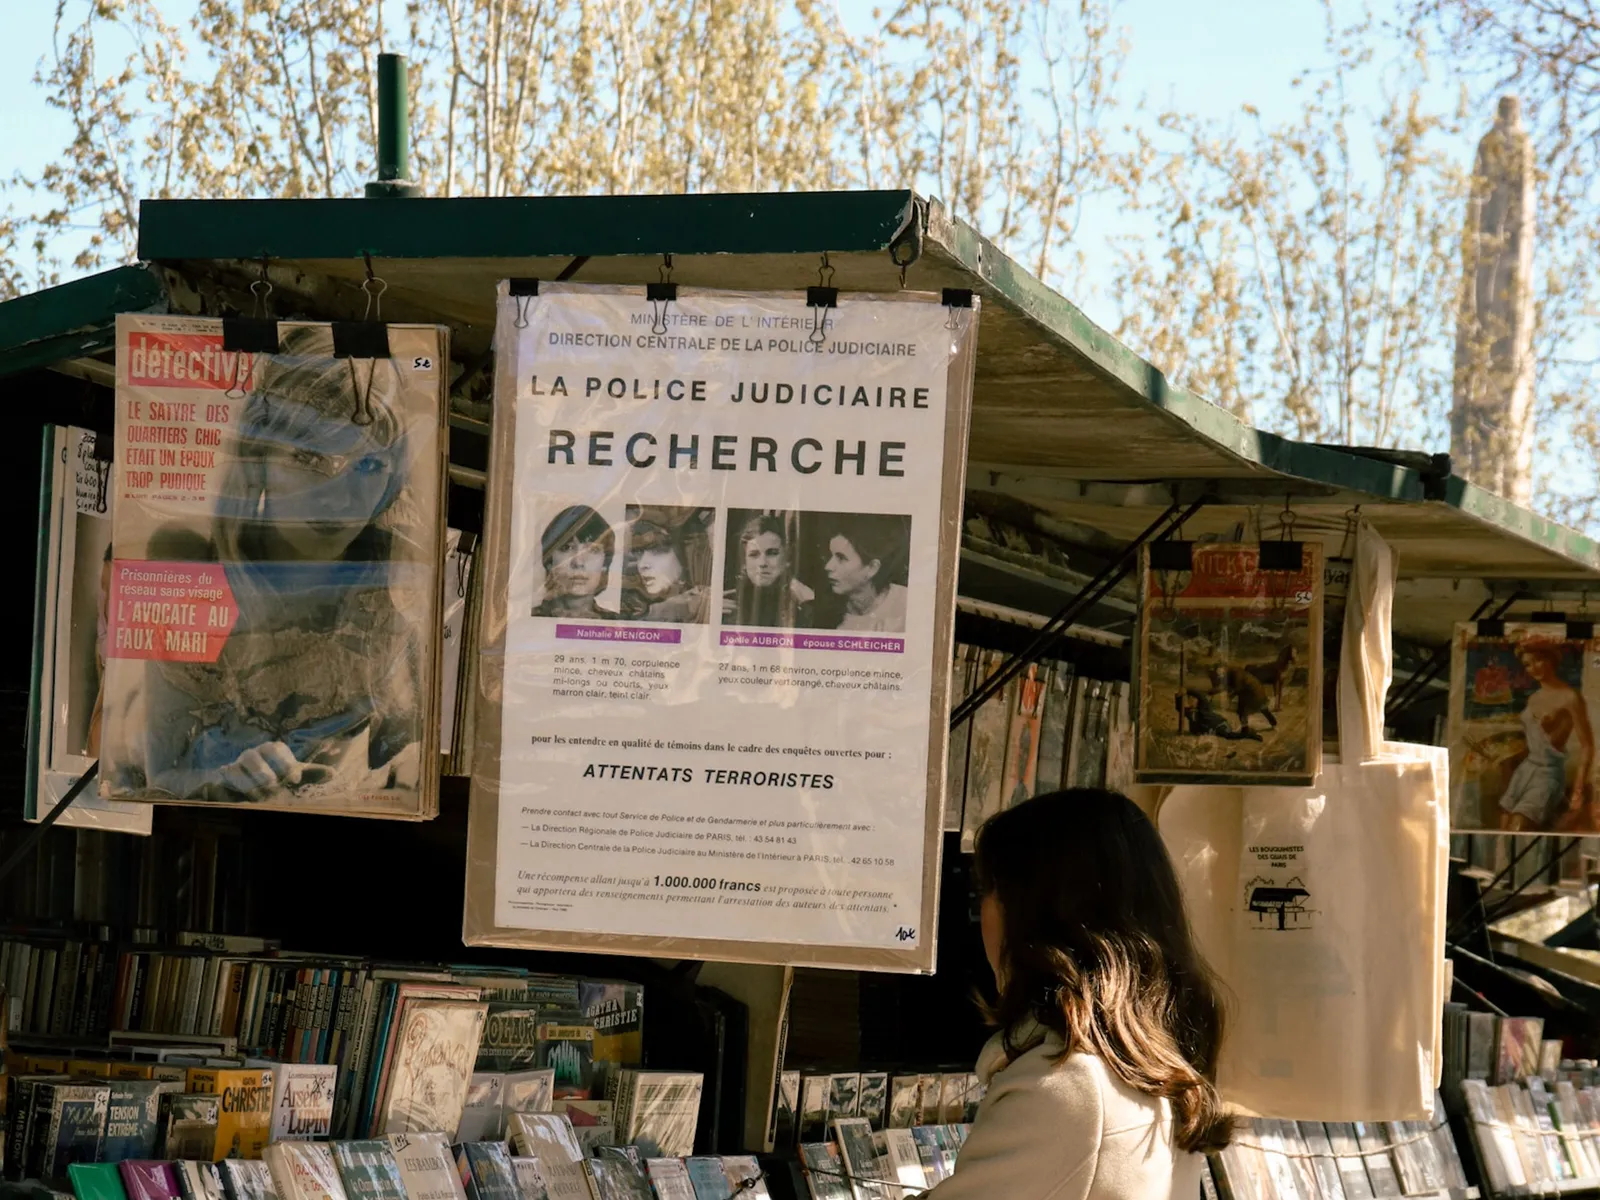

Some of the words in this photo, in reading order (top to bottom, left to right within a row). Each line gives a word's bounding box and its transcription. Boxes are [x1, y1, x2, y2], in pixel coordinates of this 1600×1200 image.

[715, 314, 735, 328] DE
[549, 332, 632, 348] DIRECTION
[636, 334, 715, 352] CENTRALE
[720, 337, 741, 352] DE
[744, 338, 764, 352] LA
[768, 338, 824, 354] POLICE
[828, 340, 916, 357] JUDICIAIRE
[531, 374, 568, 397] LA
[586, 376, 707, 402] POLICE
[730, 382, 931, 410] JUDICIAIRE
[128, 400, 141, 420] LE
[149, 402, 196, 422] SATYRE
[206, 404, 230, 423] DES
[128, 426, 188, 444] QUARTIERS
[195, 428, 222, 446] CHIC
[126, 444, 156, 466] ÉTAIT
[160, 449, 176, 466] UN
[180, 446, 214, 468] ÉPOUX
[547, 428, 907, 478] RECHERCHE
[126, 471, 154, 488] TROP
[160, 472, 206, 491] PUDIQUE
[120, 568, 192, 584] Prisonnières
[198, 572, 212, 585] du
[120, 584, 156, 596] réseau
[160, 587, 185, 597] sans
[188, 585, 222, 602] visage
[118, 600, 197, 626] L'AVOCATE
[208, 606, 228, 628] AU
[116, 627, 154, 650] FAUX
[166, 630, 208, 654] MARI
[576, 629, 612, 638] Nathalie
[614, 631, 660, 640] MENIGON
[752, 637, 794, 646] AUBRON
[803, 638, 836, 650] épouse
[838, 640, 901, 650] SCHLEICHER
[554, 654, 565, 664] 29
[631, 660, 680, 670] corpulence
[588, 668, 623, 676] cheveux
[718, 662, 729, 671] 27
[770, 665, 781, 673] 68
[718, 676, 738, 686] yeux
[740, 676, 772, 686] couleur
[552, 689, 584, 697] marron
[531, 735, 551, 744] pour
[554, 735, 566, 744] les
[568, 736, 606, 746] entendre
[622, 738, 652, 750] qualité
[654, 740, 665, 748] de
[668, 742, 702, 750] témoins
[704, 743, 725, 752] dans
[727, 744, 736, 752] le
[738, 744, 762, 754] cadre
[765, 746, 780, 754] des
[782, 746, 821, 758] enquêtes
[824, 748, 862, 758] ouvertes
[864, 751, 886, 760] pour
[583, 764, 693, 783] ATTENTATS
[704, 769, 834, 790] TERRORISTES
[522, 806, 552, 816] Prendre
[553, 809, 582, 817] contact
[602, 811, 618, 819] tout
[620, 812, 648, 820] Service
[650, 813, 660, 821] de
[661, 814, 685, 822] Police
[708, 816, 758, 826] Gendarmerie
[768, 819, 785, 828] plus
[852, 824, 870, 832] avec
[532, 824, 541, 832] La
[542, 824, 577, 834] Direction
[579, 826, 617, 836] Régionale
[619, 828, 628, 836] de
[630, 828, 654, 838] Police
[656, 830, 692, 839] Judiciaire
[695, 832, 705, 840] de
[754, 834, 764, 843] 43
[776, 836, 785, 844] 81
[786, 836, 797, 844] 43
[530, 840, 540, 848] La
[542, 841, 576, 850] Direction
[578, 842, 610, 852] Centrale
[612, 844, 622, 852] de
[632, 846, 656, 854] Police
[657, 846, 696, 856] Judiciaire
[708, 850, 744, 860] Ministère
[746, 852, 756, 860] de
[851, 856, 862, 864] 42
[884, 858, 894, 866] 58
[518, 870, 536, 880] Une
[536, 872, 588, 885] récompense
[590, 874, 616, 885] allant
[653, 875, 716, 890] 1.000.000
[719, 878, 761, 892] francs
[764, 884, 776, 894] est
[777, 886, 818, 896] proposée
[852, 890, 894, 900] personne
[516, 886, 531, 896] qui
[532, 886, 577, 898] apportera
[578, 888, 594, 898] des
[596, 889, 664, 902] renseignements
[666, 893, 715, 904] permettant
[775, 898, 791, 908] des
[792, 901, 826, 910] auteurs
[586, 998, 619, 1018] AGATHA
[592, 1008, 638, 1030] CHRISTIE
[222, 1086, 271, 1112] CHRISTIE
[110, 1106, 140, 1120] TENSION
[288, 1110, 328, 1134] LUPIN
